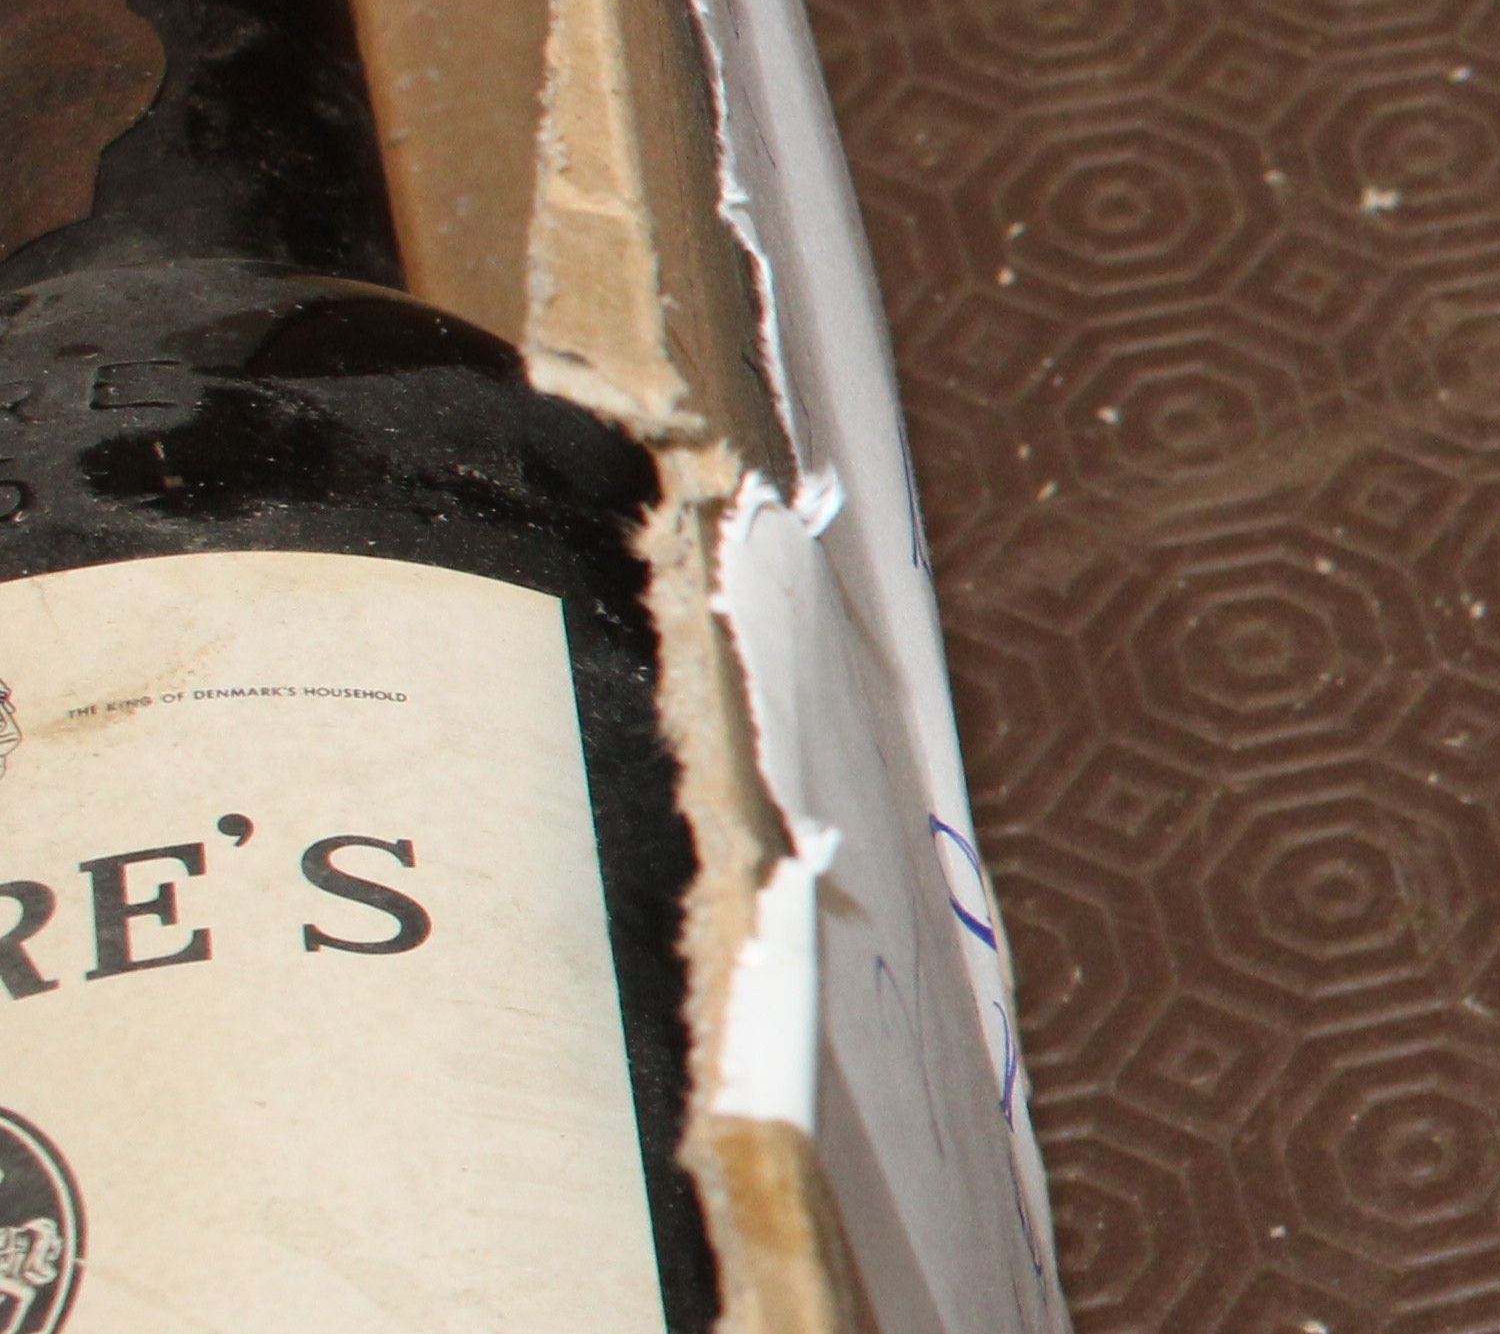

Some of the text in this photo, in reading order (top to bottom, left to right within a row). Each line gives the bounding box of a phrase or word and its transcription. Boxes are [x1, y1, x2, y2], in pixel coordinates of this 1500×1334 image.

[67, 685, 408, 720] THE KING OF DENMARK'S HOUSEHOLD
